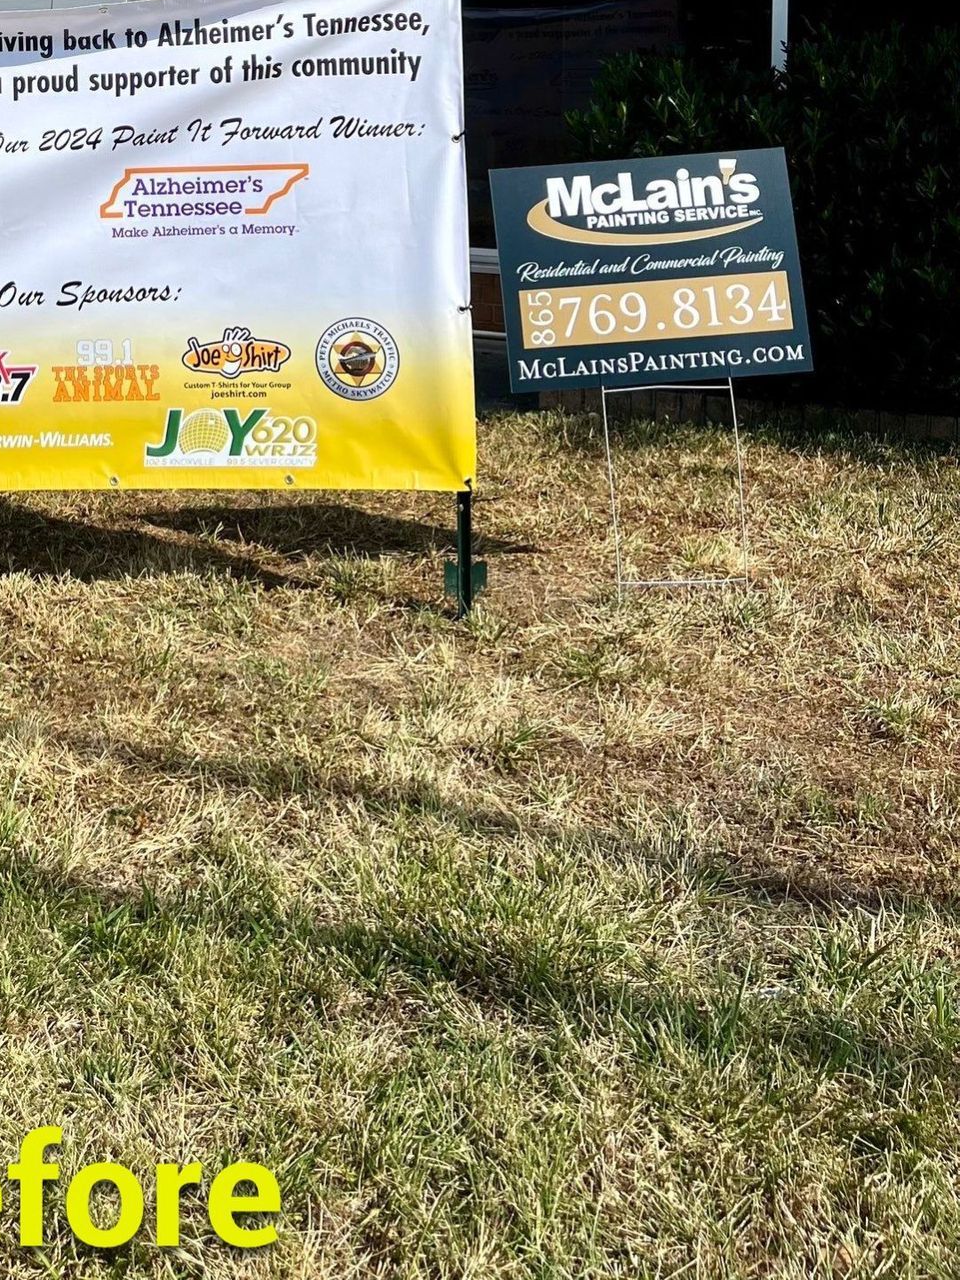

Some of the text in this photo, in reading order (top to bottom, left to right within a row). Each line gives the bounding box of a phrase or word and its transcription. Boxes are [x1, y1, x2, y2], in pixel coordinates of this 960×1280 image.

[63, 28, 116, 52] back
[125, 27, 148, 49] to
[158, 13, 295, 47] Alzheimer's
[303, 10, 430, 36] Tennessee,
[12, 65, 78, 100] proud
[89, 65, 200, 97] supporter
[210, 58, 233, 84] of
[242, 54, 283, 81] this
[291, 48, 422, 82] community
[39, 127, 102, 152] 2024
[111, 124, 179, 152] Paint
[186, 119, 210, 143] It
[219, 116, 323, 147] Forward
[329, 114, 426, 139] Winner:
[131, 176, 264, 196] Alzheimer's
[545, 158, 760, 217] McLain's
[124, 199, 242, 218] Tennessee
[587, 211, 670, 229] PAINTING
[674, 204, 749, 222] SERVICE
[112, 223, 296, 238] Make Alzheimer's a Memory
[516, 245, 785, 283] Residential and Commercial Painting
[56, 280, 183, 311] Sponsors:
[558, 280, 787, 338] 769.8134
[527, 291, 556, 346] 865
[76, 338, 133, 365] 99.1
[191, 340, 281, 368] Joe Shirt
[319, 321, 396, 361] PETE MICHAELS TRAFFIC
[52, 364, 160, 381] THE SPORTS
[268, 381, 291, 389] Group
[322, 370, 393, 397] METRO SKYWATCH
[53, 380, 160, 402] ANIMAL
[211, 390, 267, 399] joeshirt.com
[251, 417, 316, 444] 620
[244, 444, 317, 457] WRJZ
